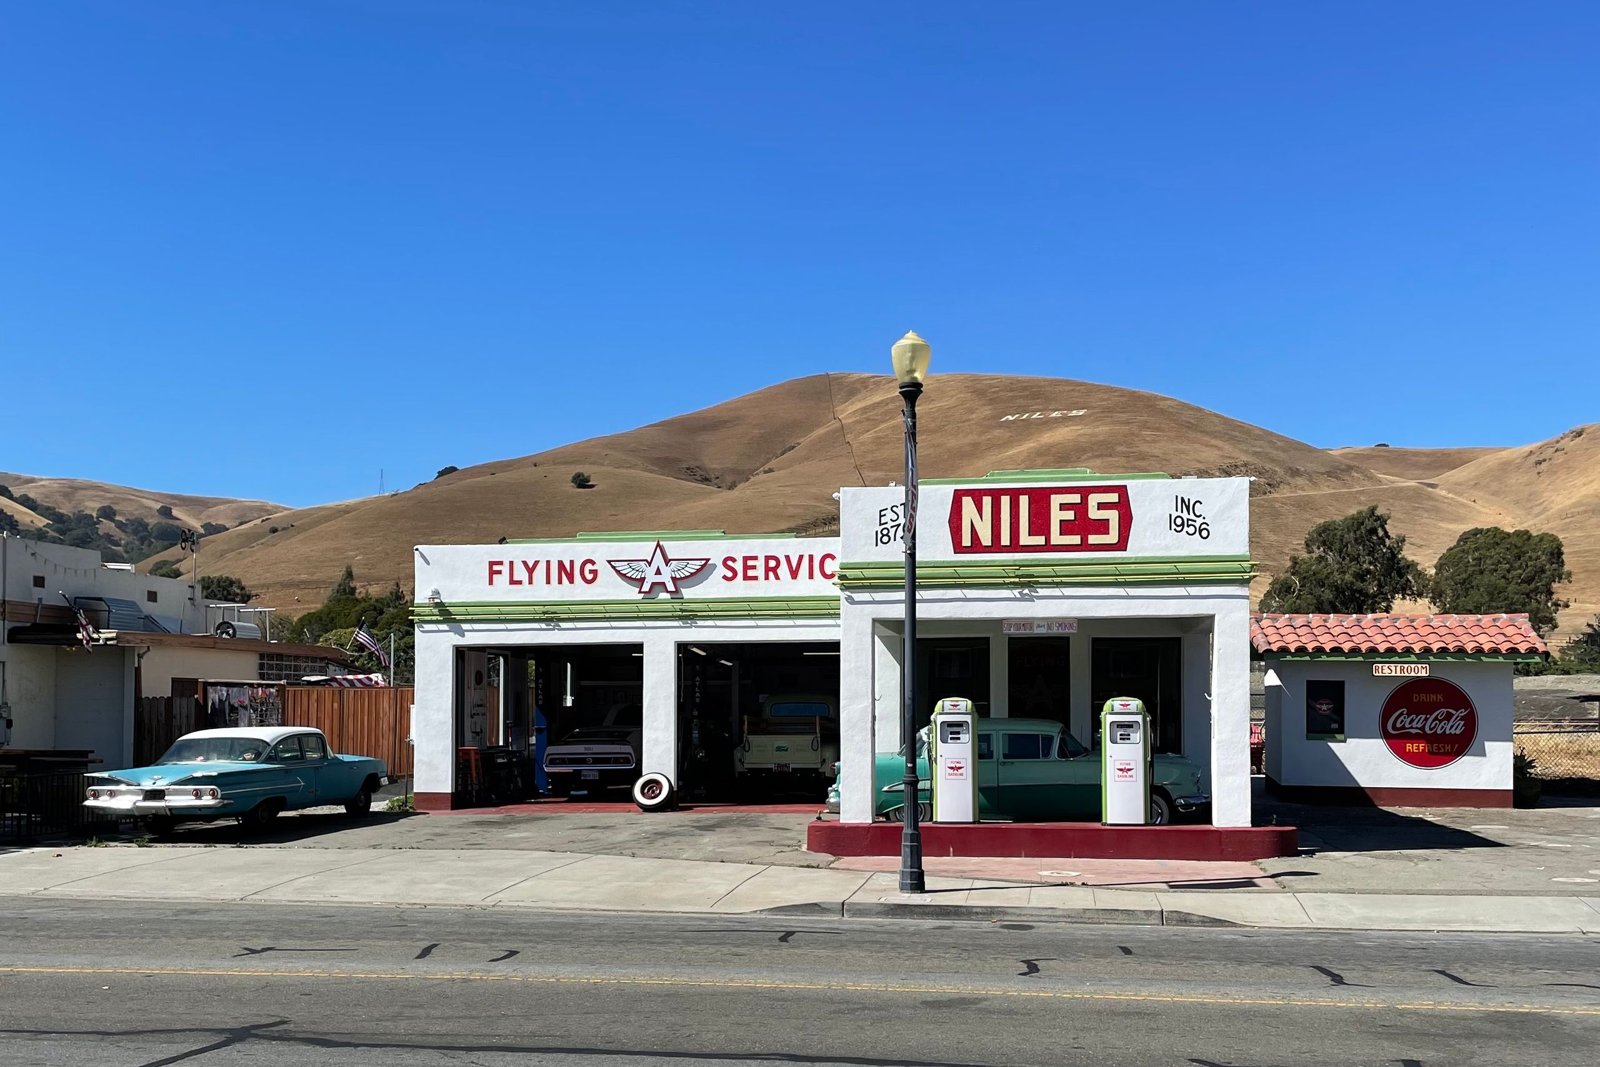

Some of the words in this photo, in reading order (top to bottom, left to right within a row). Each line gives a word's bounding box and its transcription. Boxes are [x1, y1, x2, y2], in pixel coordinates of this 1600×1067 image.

[999, 409, 1088, 422] NILES
[1175, 495, 1206, 520] INC.
[961, 493, 1120, 547] NILES
[1169, 513, 1210, 540] 1956
[875, 523, 905, 547] 187
[488, 558, 599, 586] FLYING
[638, 539, 680, 594] A
[1374, 665, 1428, 675] RESTROOM
[1413, 693, 1444, 702] DRINK
[1387, 708, 1471, 735] Coca-Cola
[1406, 743, 1459, 755] REFRESH!
